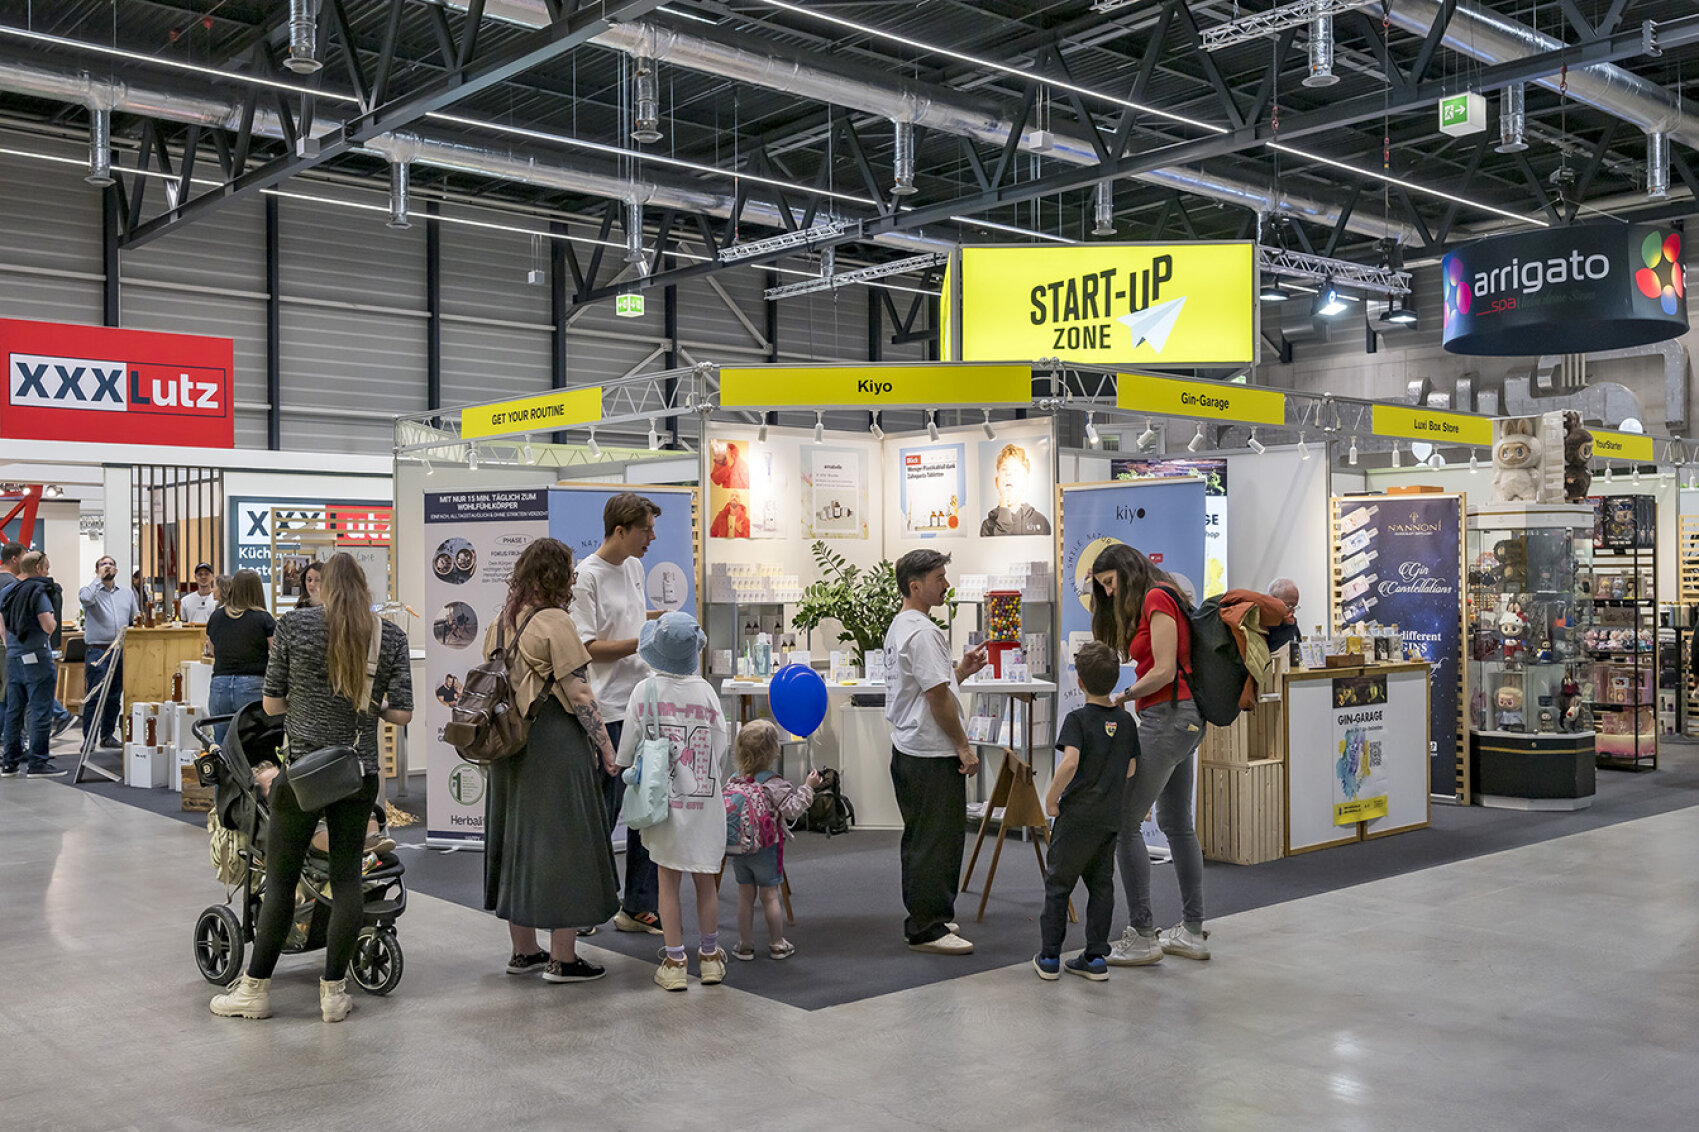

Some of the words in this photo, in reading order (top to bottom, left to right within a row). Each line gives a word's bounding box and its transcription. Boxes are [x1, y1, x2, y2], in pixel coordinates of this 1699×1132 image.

[1473, 249, 1610, 298] arrigato
[1030, 253, 1173, 326] START-UP
[1490, 297, 1517, 313] spa
[1053, 324, 1111, 350] ZONE
[14, 361, 219, 410] XXXLutz
[857, 379, 893, 397] Kiyo
[1181, 391, 1230, 411] Gin-Garage
[491, 411, 506, 426] GET
[507, 408, 529, 424] YOUR
[530, 403, 565, 421] ROUTINE
[1413, 418, 1428, 430] Luxi
[1428, 420, 1442, 432] Box
[1441, 421, 1460, 434] Store
[1337, 710, 1384, 726] GIN-GARAGE
